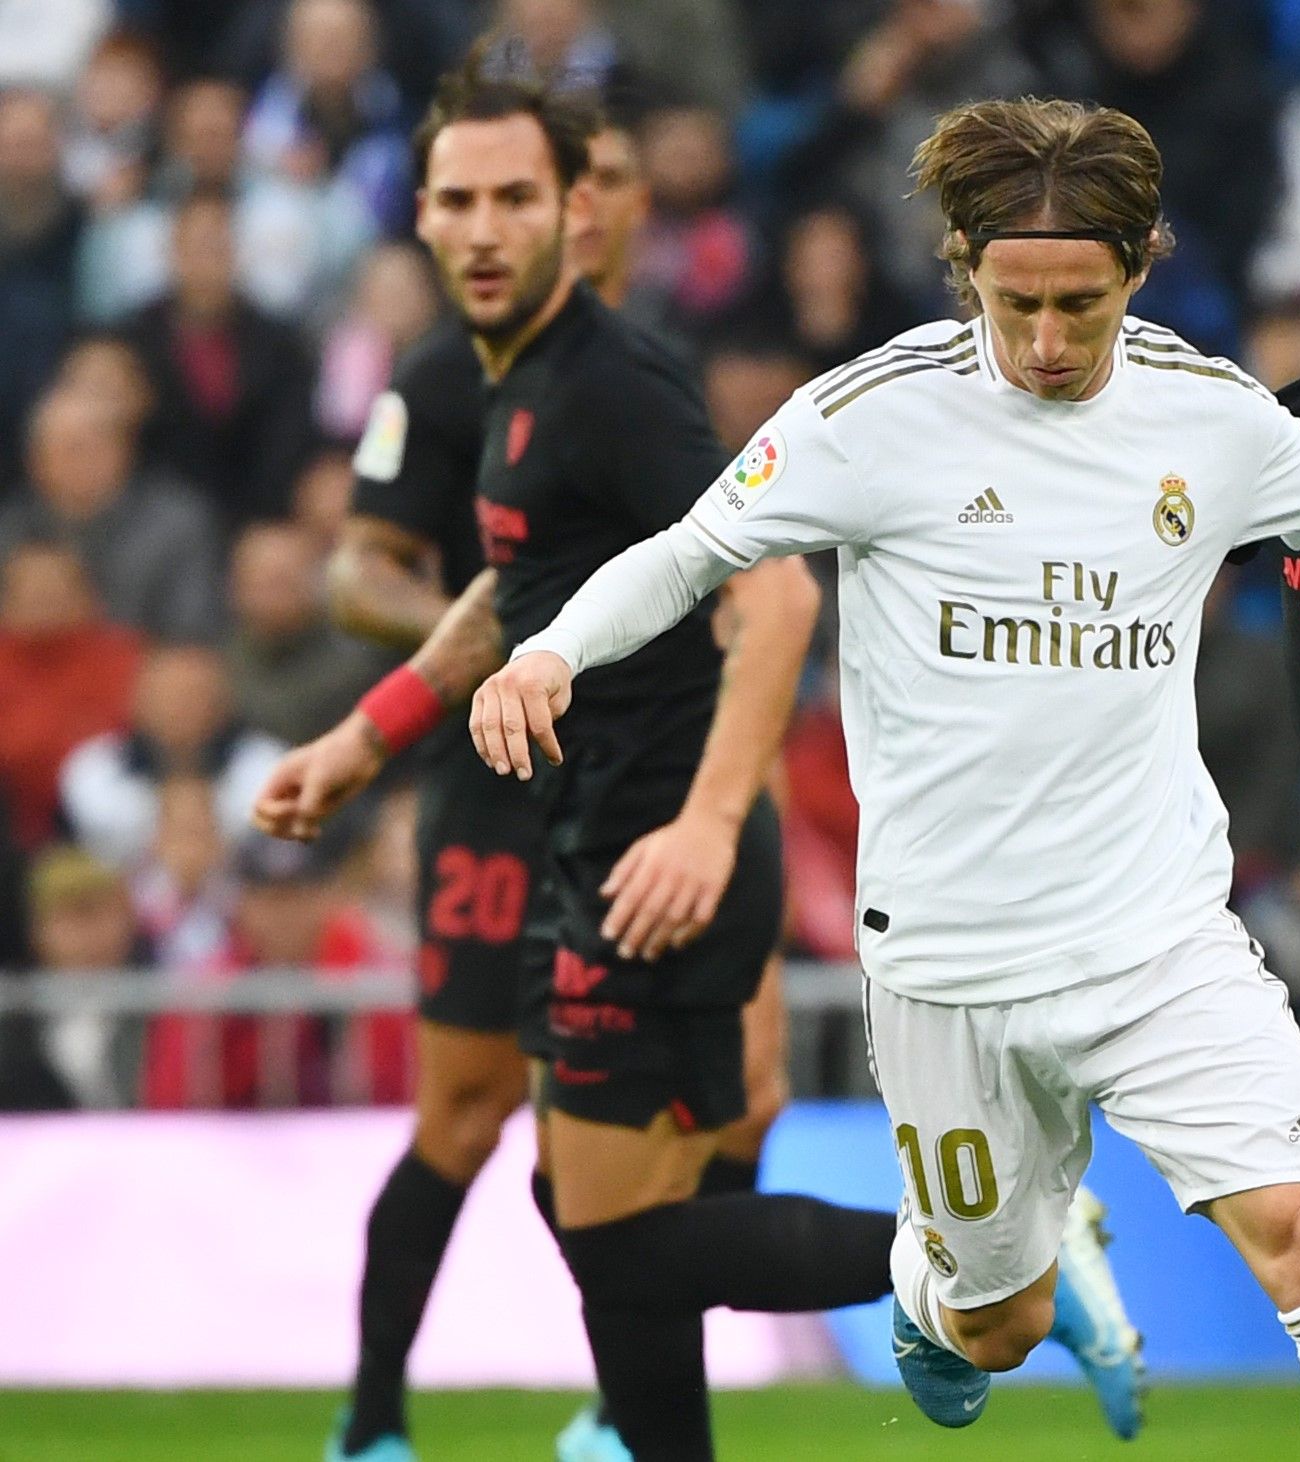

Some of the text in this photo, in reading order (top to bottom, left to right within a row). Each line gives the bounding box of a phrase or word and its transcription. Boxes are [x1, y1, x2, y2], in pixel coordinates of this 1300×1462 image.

[957, 509, 1014, 524] adidas
[1041, 561, 1119, 612] Fly
[938, 599, 1177, 671] Emirates
[430, 843, 530, 943] 20
[896, 1122, 1000, 1221] 10
